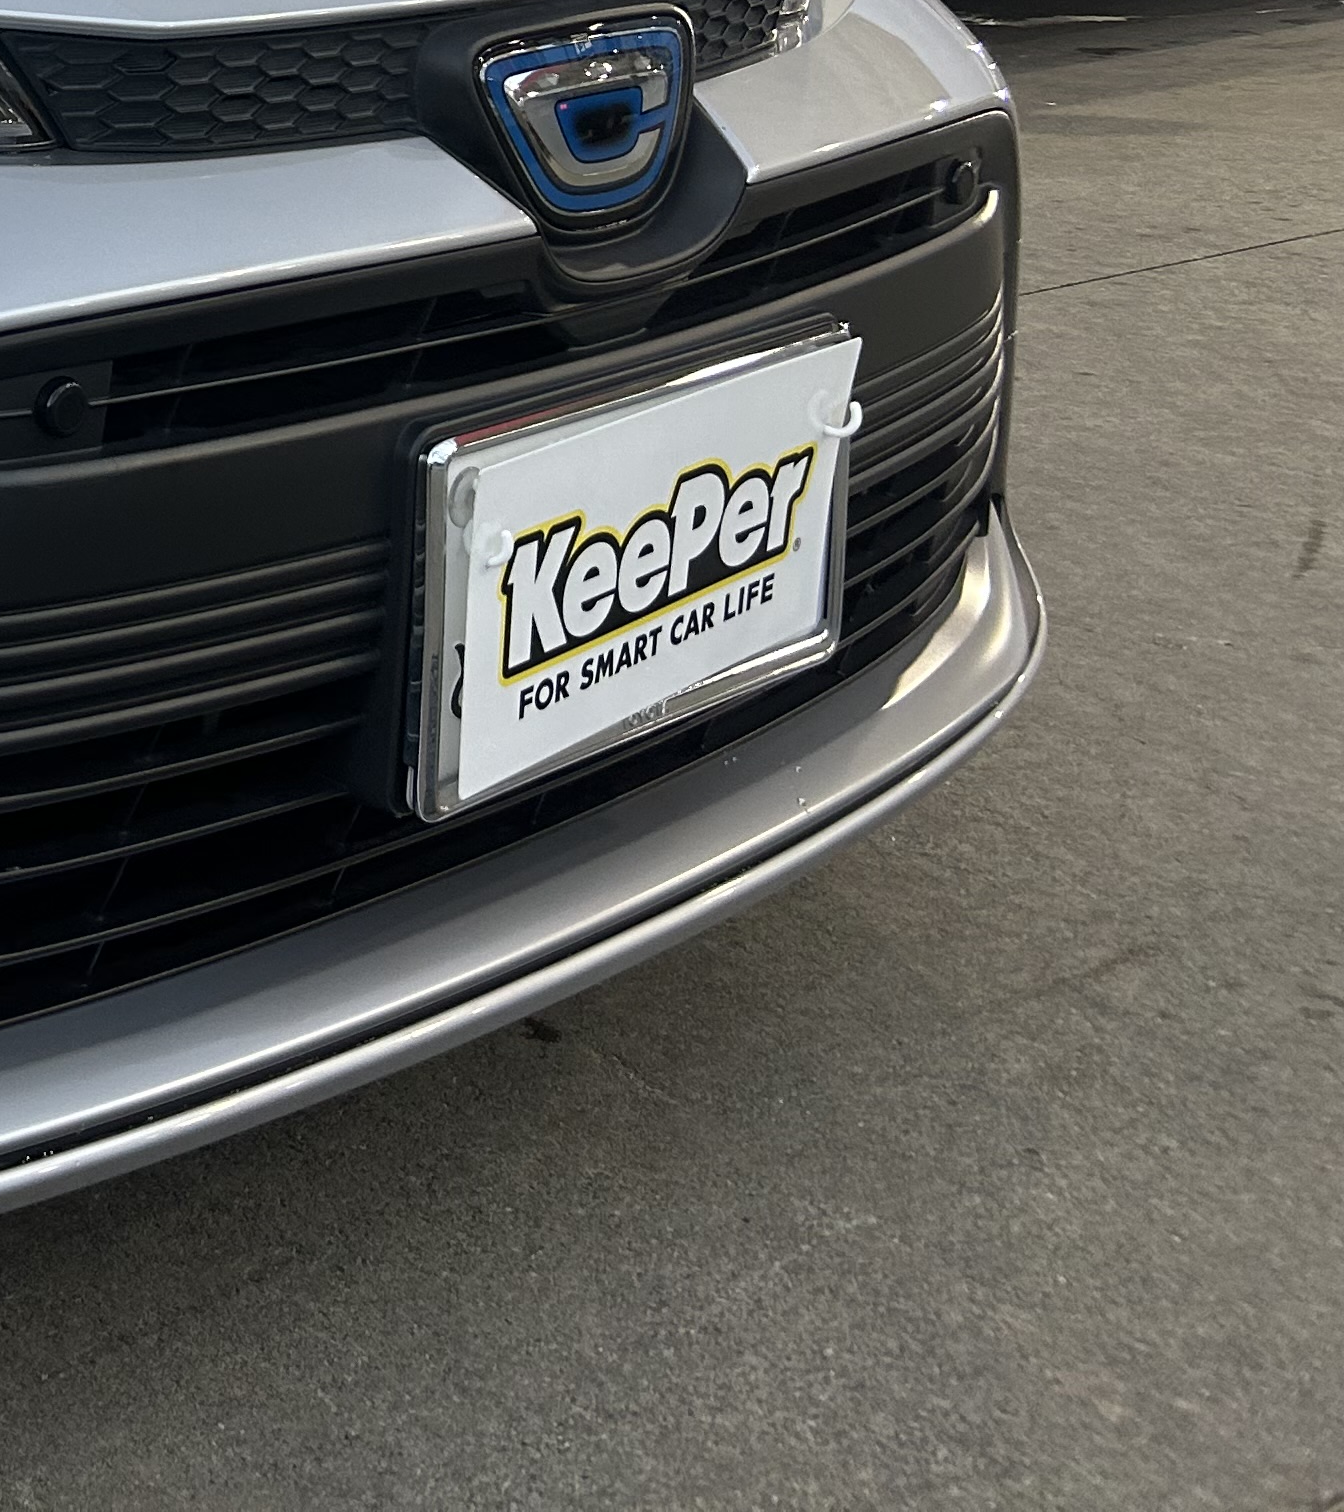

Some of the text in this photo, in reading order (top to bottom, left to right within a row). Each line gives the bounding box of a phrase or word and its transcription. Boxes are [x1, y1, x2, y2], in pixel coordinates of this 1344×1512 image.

[502, 450, 814, 676] KeePer
[519, 574, 775, 719] FOR SMART CAR LIFE
